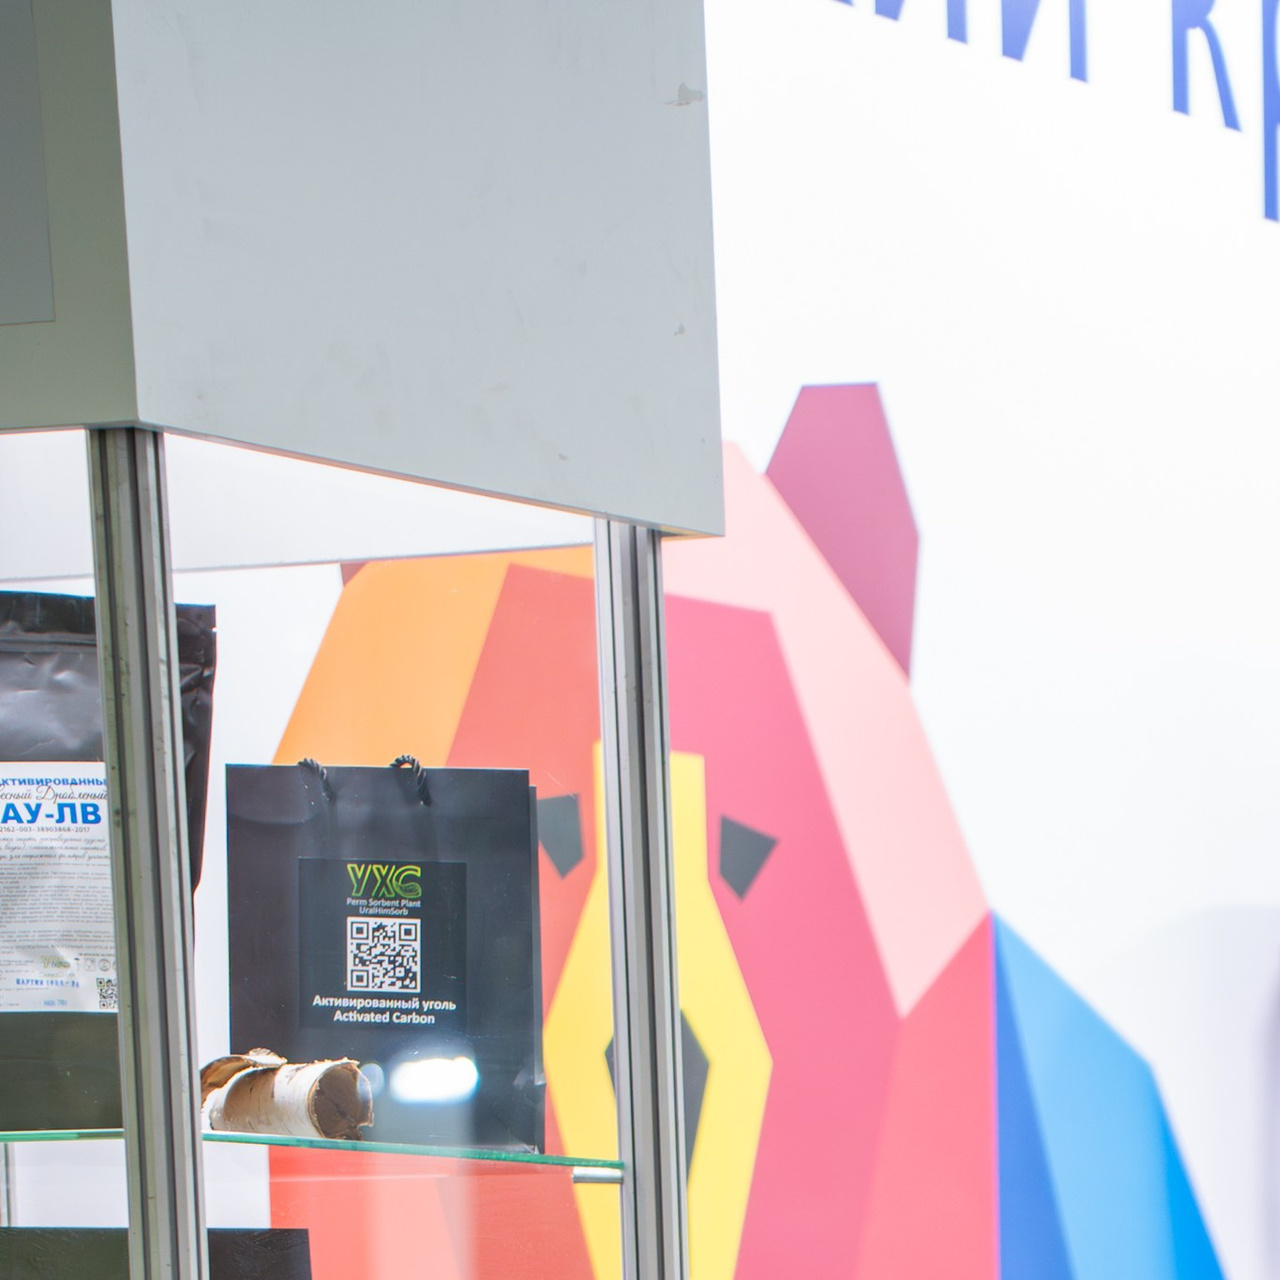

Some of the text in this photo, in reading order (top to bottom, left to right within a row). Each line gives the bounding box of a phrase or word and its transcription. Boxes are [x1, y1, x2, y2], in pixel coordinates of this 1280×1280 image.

[0, 784, 31, 800] есный
[369, 898, 399, 906] Sorbent
[359, 906, 409, 915] UralHimSorb
[313, 994, 456, 1011] Активированный уголь
[334, 1010, 435, 1024] Activated Carbon
